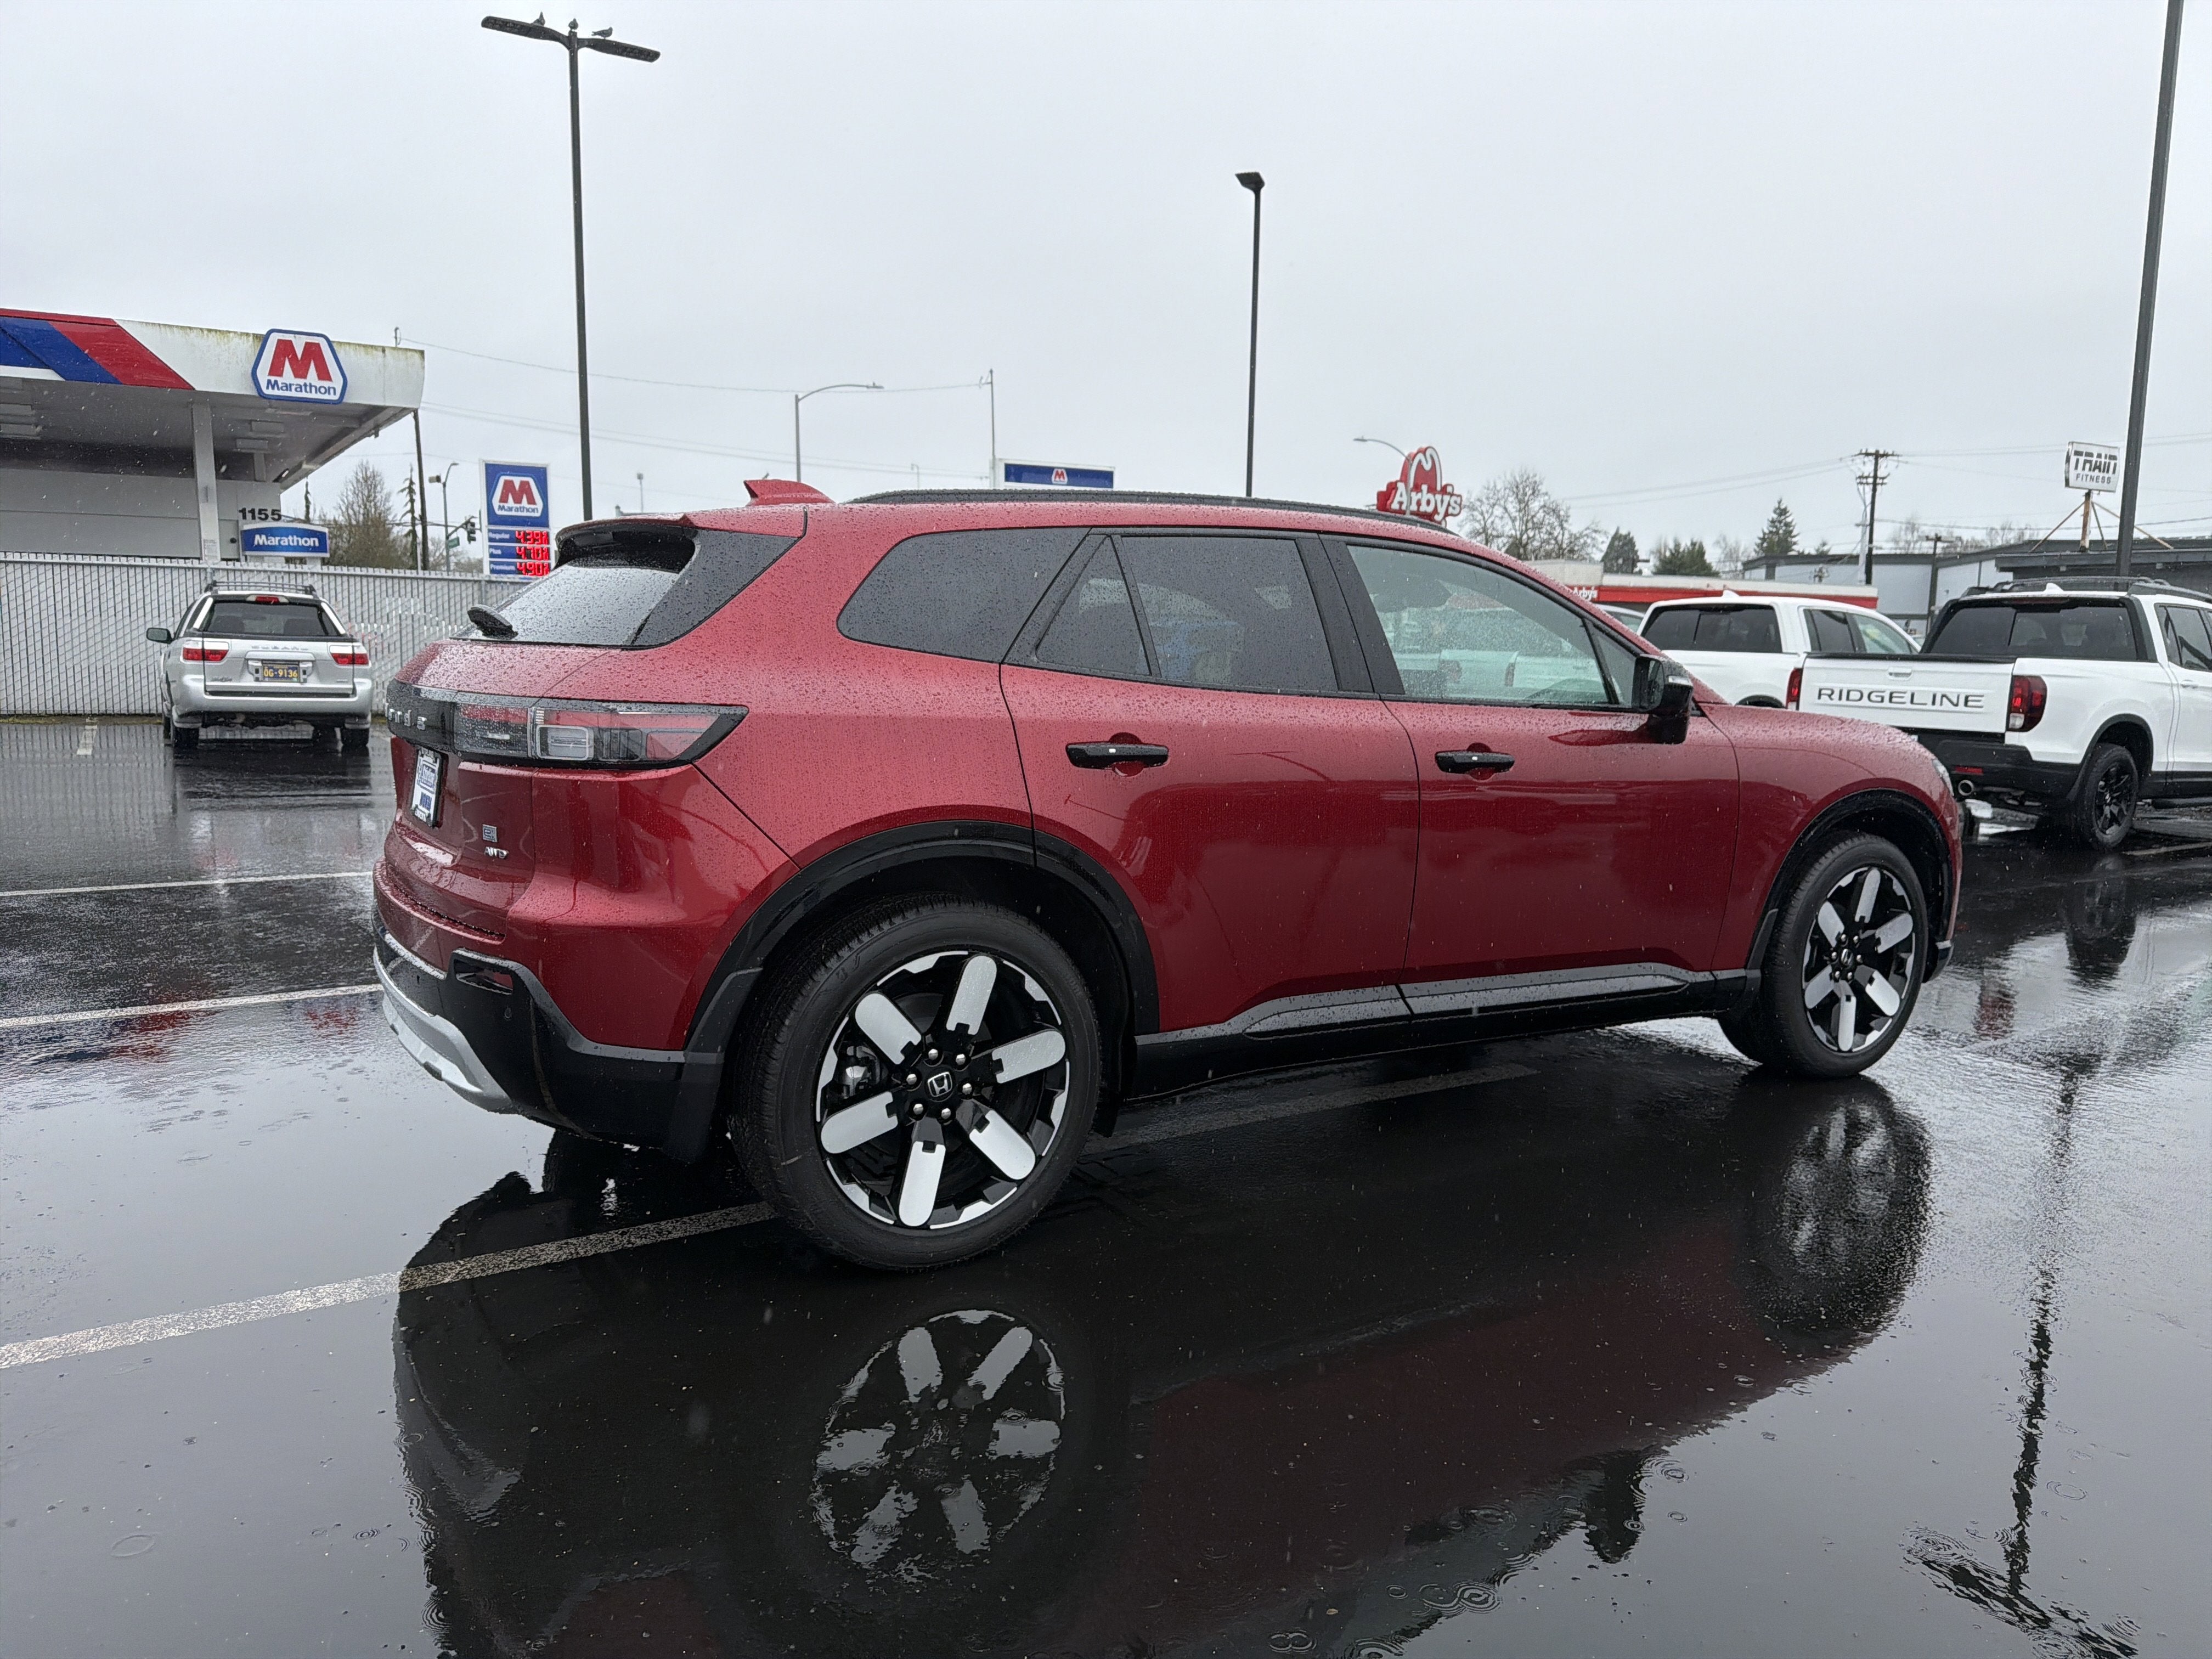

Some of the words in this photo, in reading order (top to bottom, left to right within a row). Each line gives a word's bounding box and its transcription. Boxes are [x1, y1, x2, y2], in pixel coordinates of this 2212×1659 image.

[268, 338, 333, 382] M
[266, 379, 337, 396] Marathon
[2074, 449, 2118, 475] TRAIN
[2076, 473, 2112, 484] FITNESS
[498, 479, 537, 506] M
[1391, 481, 1461, 521] Arby's
[238, 507, 282, 521] 1155
[497, 504, 539, 514] Marathon
[254, 534, 319, 547] Marathon
[1817, 687, 1985, 709] RIDGELINE
